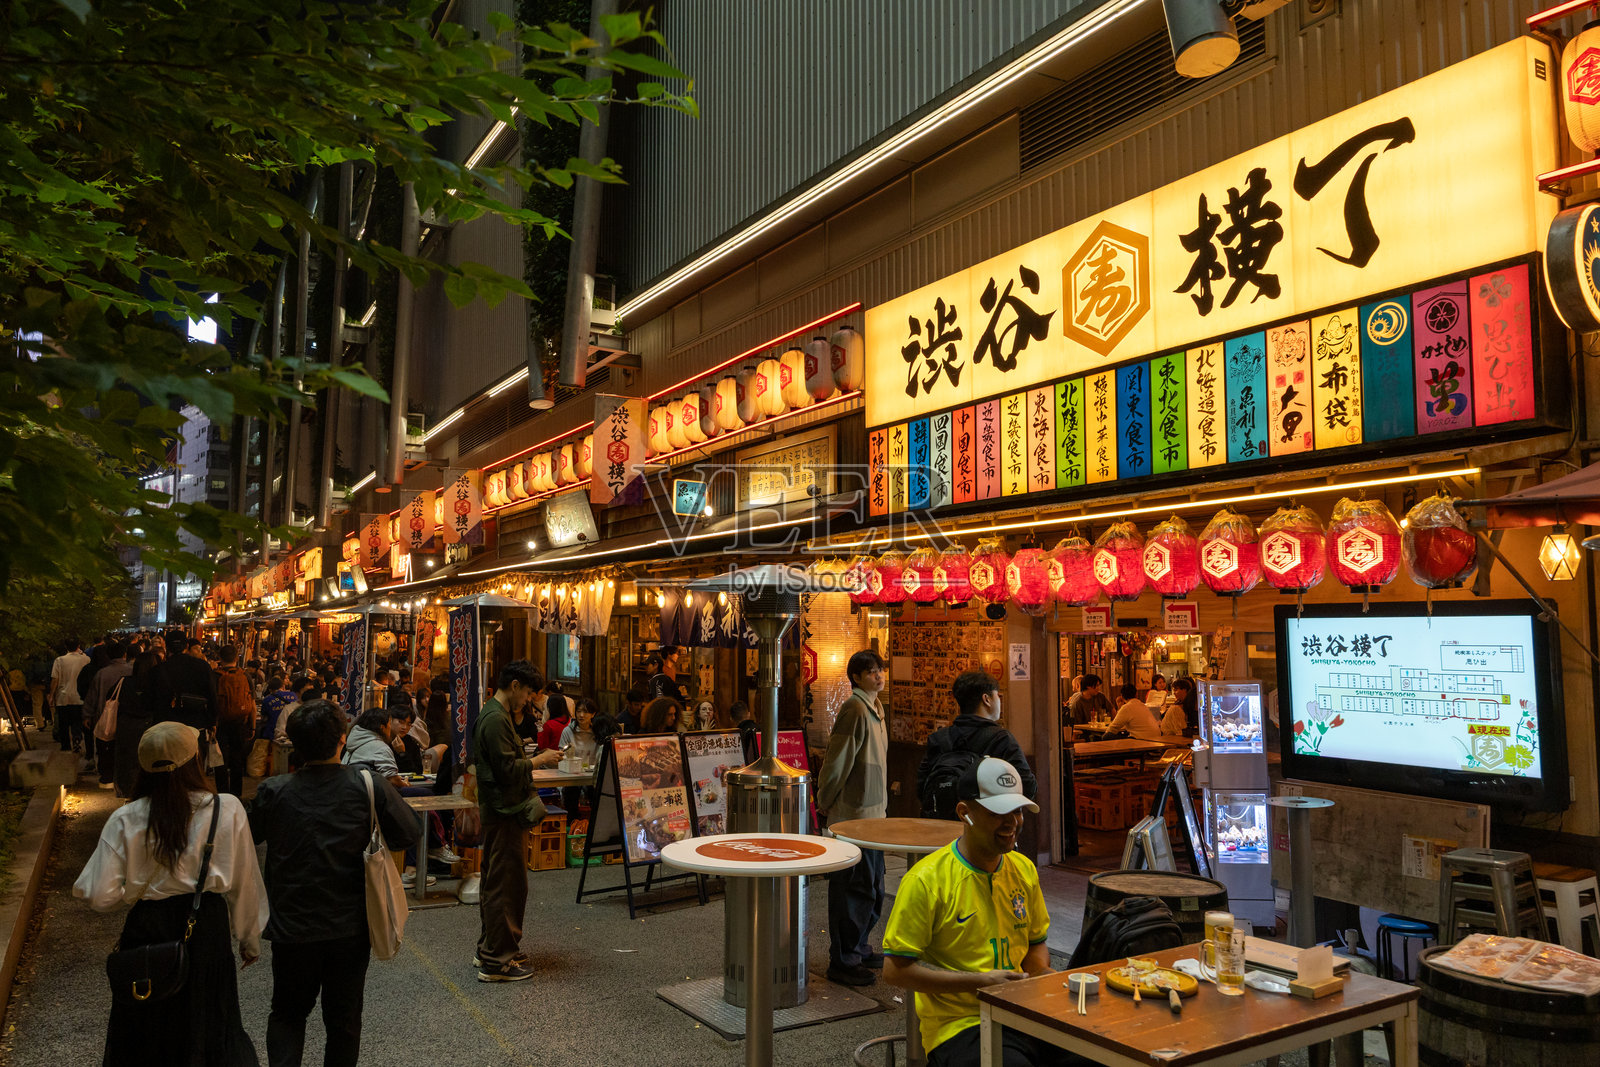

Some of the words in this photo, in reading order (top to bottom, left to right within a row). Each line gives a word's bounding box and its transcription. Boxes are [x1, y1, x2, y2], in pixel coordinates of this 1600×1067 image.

[901, 264, 1057, 397] 渋谷
[1174, 116, 1416, 317] 横丁
[1060, 382, 1082, 485] 北陸食市
[1093, 375, 1110, 479] 横浜中華食市
[1124, 366, 1145, 472] 関東食市
[1158, 358, 1180, 469] 東北食市
[1196, 349, 1218, 462] 北海道食市
[1318, 361, 1351, 430] 布袋
[872, 432, 885, 513] 沖縄食市
[892, 427, 905, 510] 九州食市
[913, 420, 928, 501] 韓国食市
[933, 414, 951, 502] 四国食市
[957, 410, 973, 500] 中国食市
[1032, 390, 1050, 490] 東海食市
[1208, 544, 1231, 572] 寿
[1268, 536, 1292, 568] 寿
[1346, 533, 1375, 568] 寿
[1301, 633, 1393, 658] 渋谷横丁
[1477, 725, 1510, 736] 現在地
[989, 936, 1015, 970] 10
